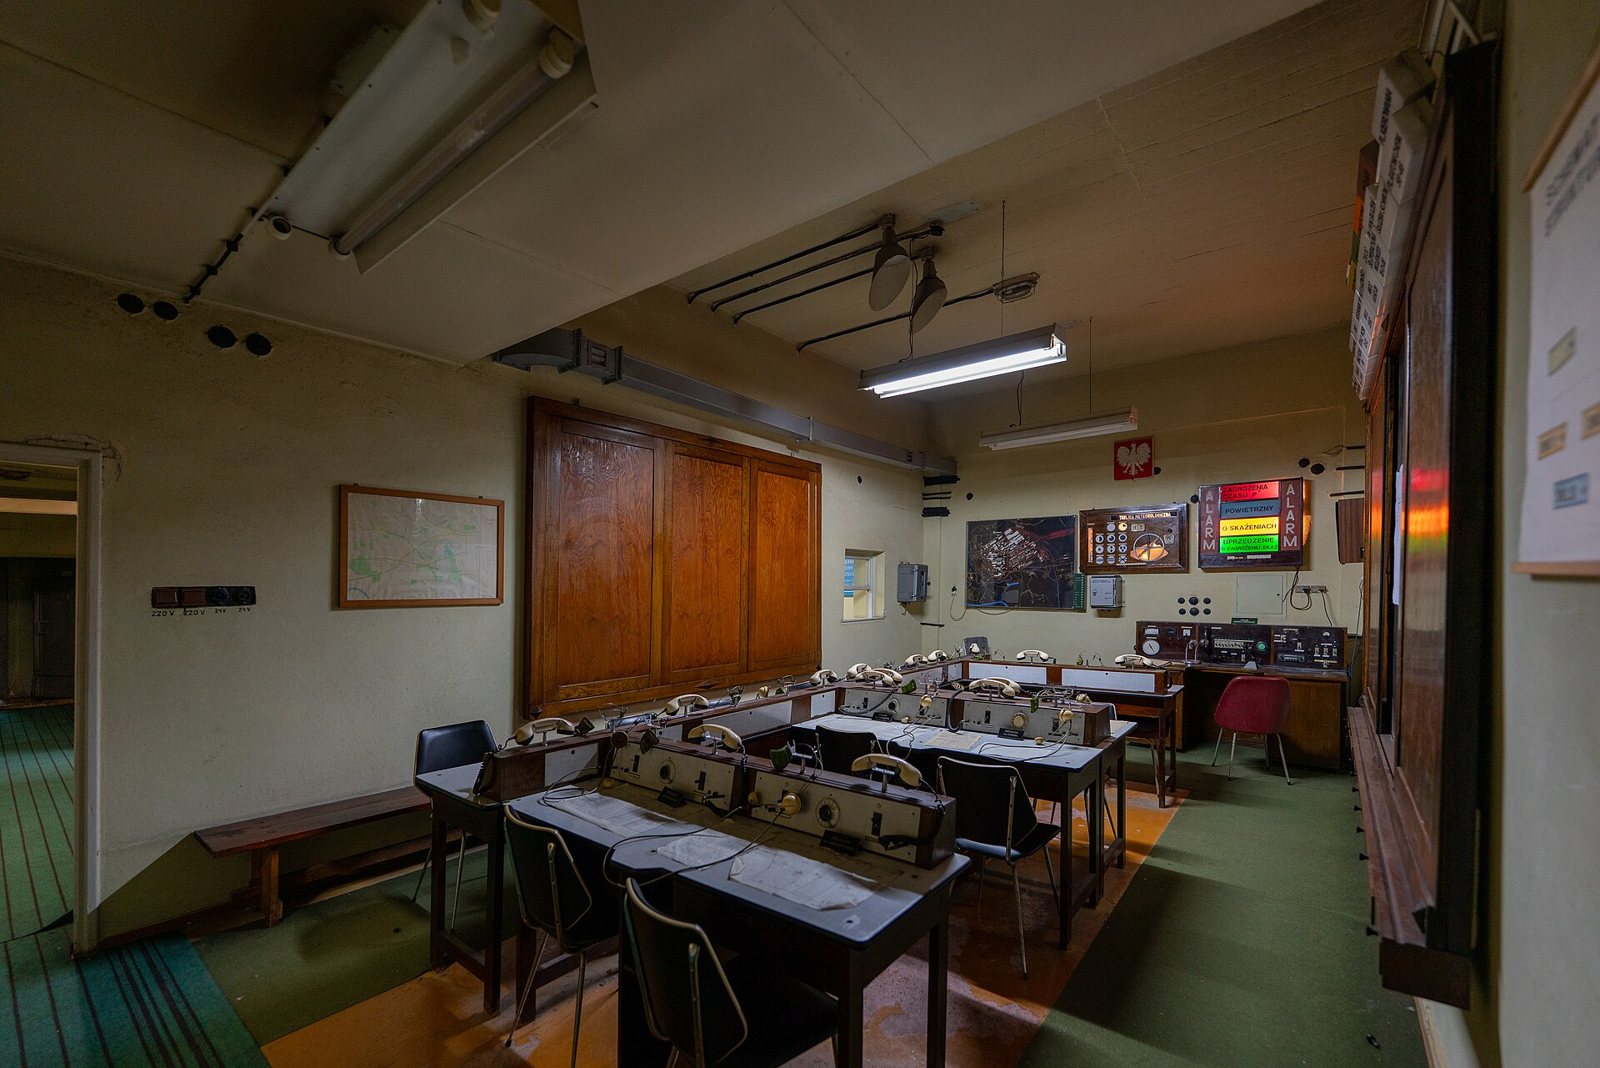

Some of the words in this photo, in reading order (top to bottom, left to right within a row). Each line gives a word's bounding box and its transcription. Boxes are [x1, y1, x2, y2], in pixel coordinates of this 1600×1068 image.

[1225, 505, 1274, 514] POWIETRZNY
[1283, 483, 1298, 547] ALARM
[1203, 490, 1216, 550] ALARM
[1229, 523, 1277, 531] SKAŻENIACH
[1223, 537, 1274, 545] UPRZEDZENIE
